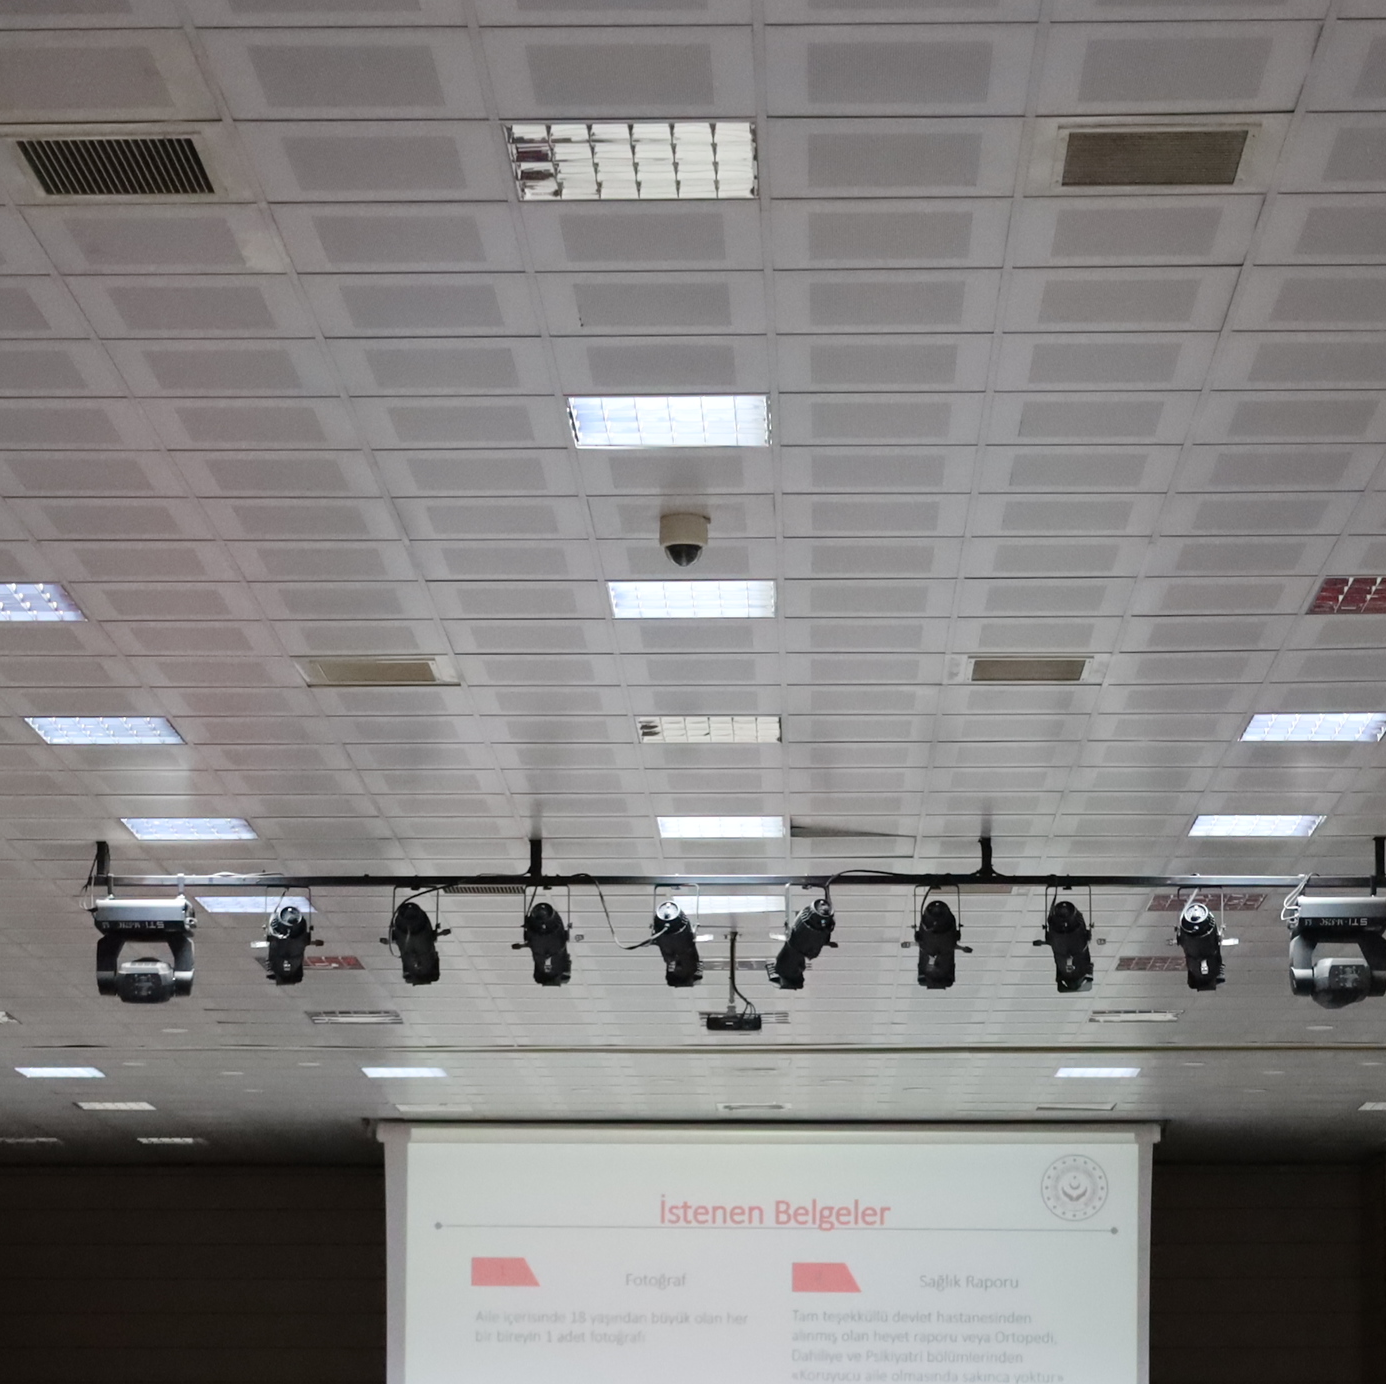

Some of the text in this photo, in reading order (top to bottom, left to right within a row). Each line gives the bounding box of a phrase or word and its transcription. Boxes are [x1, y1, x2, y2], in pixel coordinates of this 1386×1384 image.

[659, 1194, 891, 1231] İstenen Belgeler
[625, 1273, 687, 1289] Fotoğraf
[920, 1275, 1019, 1291] Sağlık Raporu
[475, 1311, 748, 1327] Aile içerisinde 18 yaşından büyük olan her
[793, 1310, 1032, 1325] Tam teşekküllü devlet hastanesinden
[475, 1331, 492, 1342] bir
[497, 1331, 540, 1345] bireyin
[547, 1331, 553, 1342] 1
[557, 1331, 585, 1342] adet
[792, 1330, 837, 1344] alınmış
[842, 1330, 869, 1342] olan
[873, 1331, 909, 1345] heyet
[914, 1332, 957, 1345] raporu
[962, 1333, 991, 1345] veya
[792, 1350, 1023, 1365] Dahiliye ve Psikiyatri bölümlerinden
[865, 1370, 887, 1382] aile
[892, 1370, 958, 1383] olmasında
[962, 1371, 1010, 1384] sakınca
